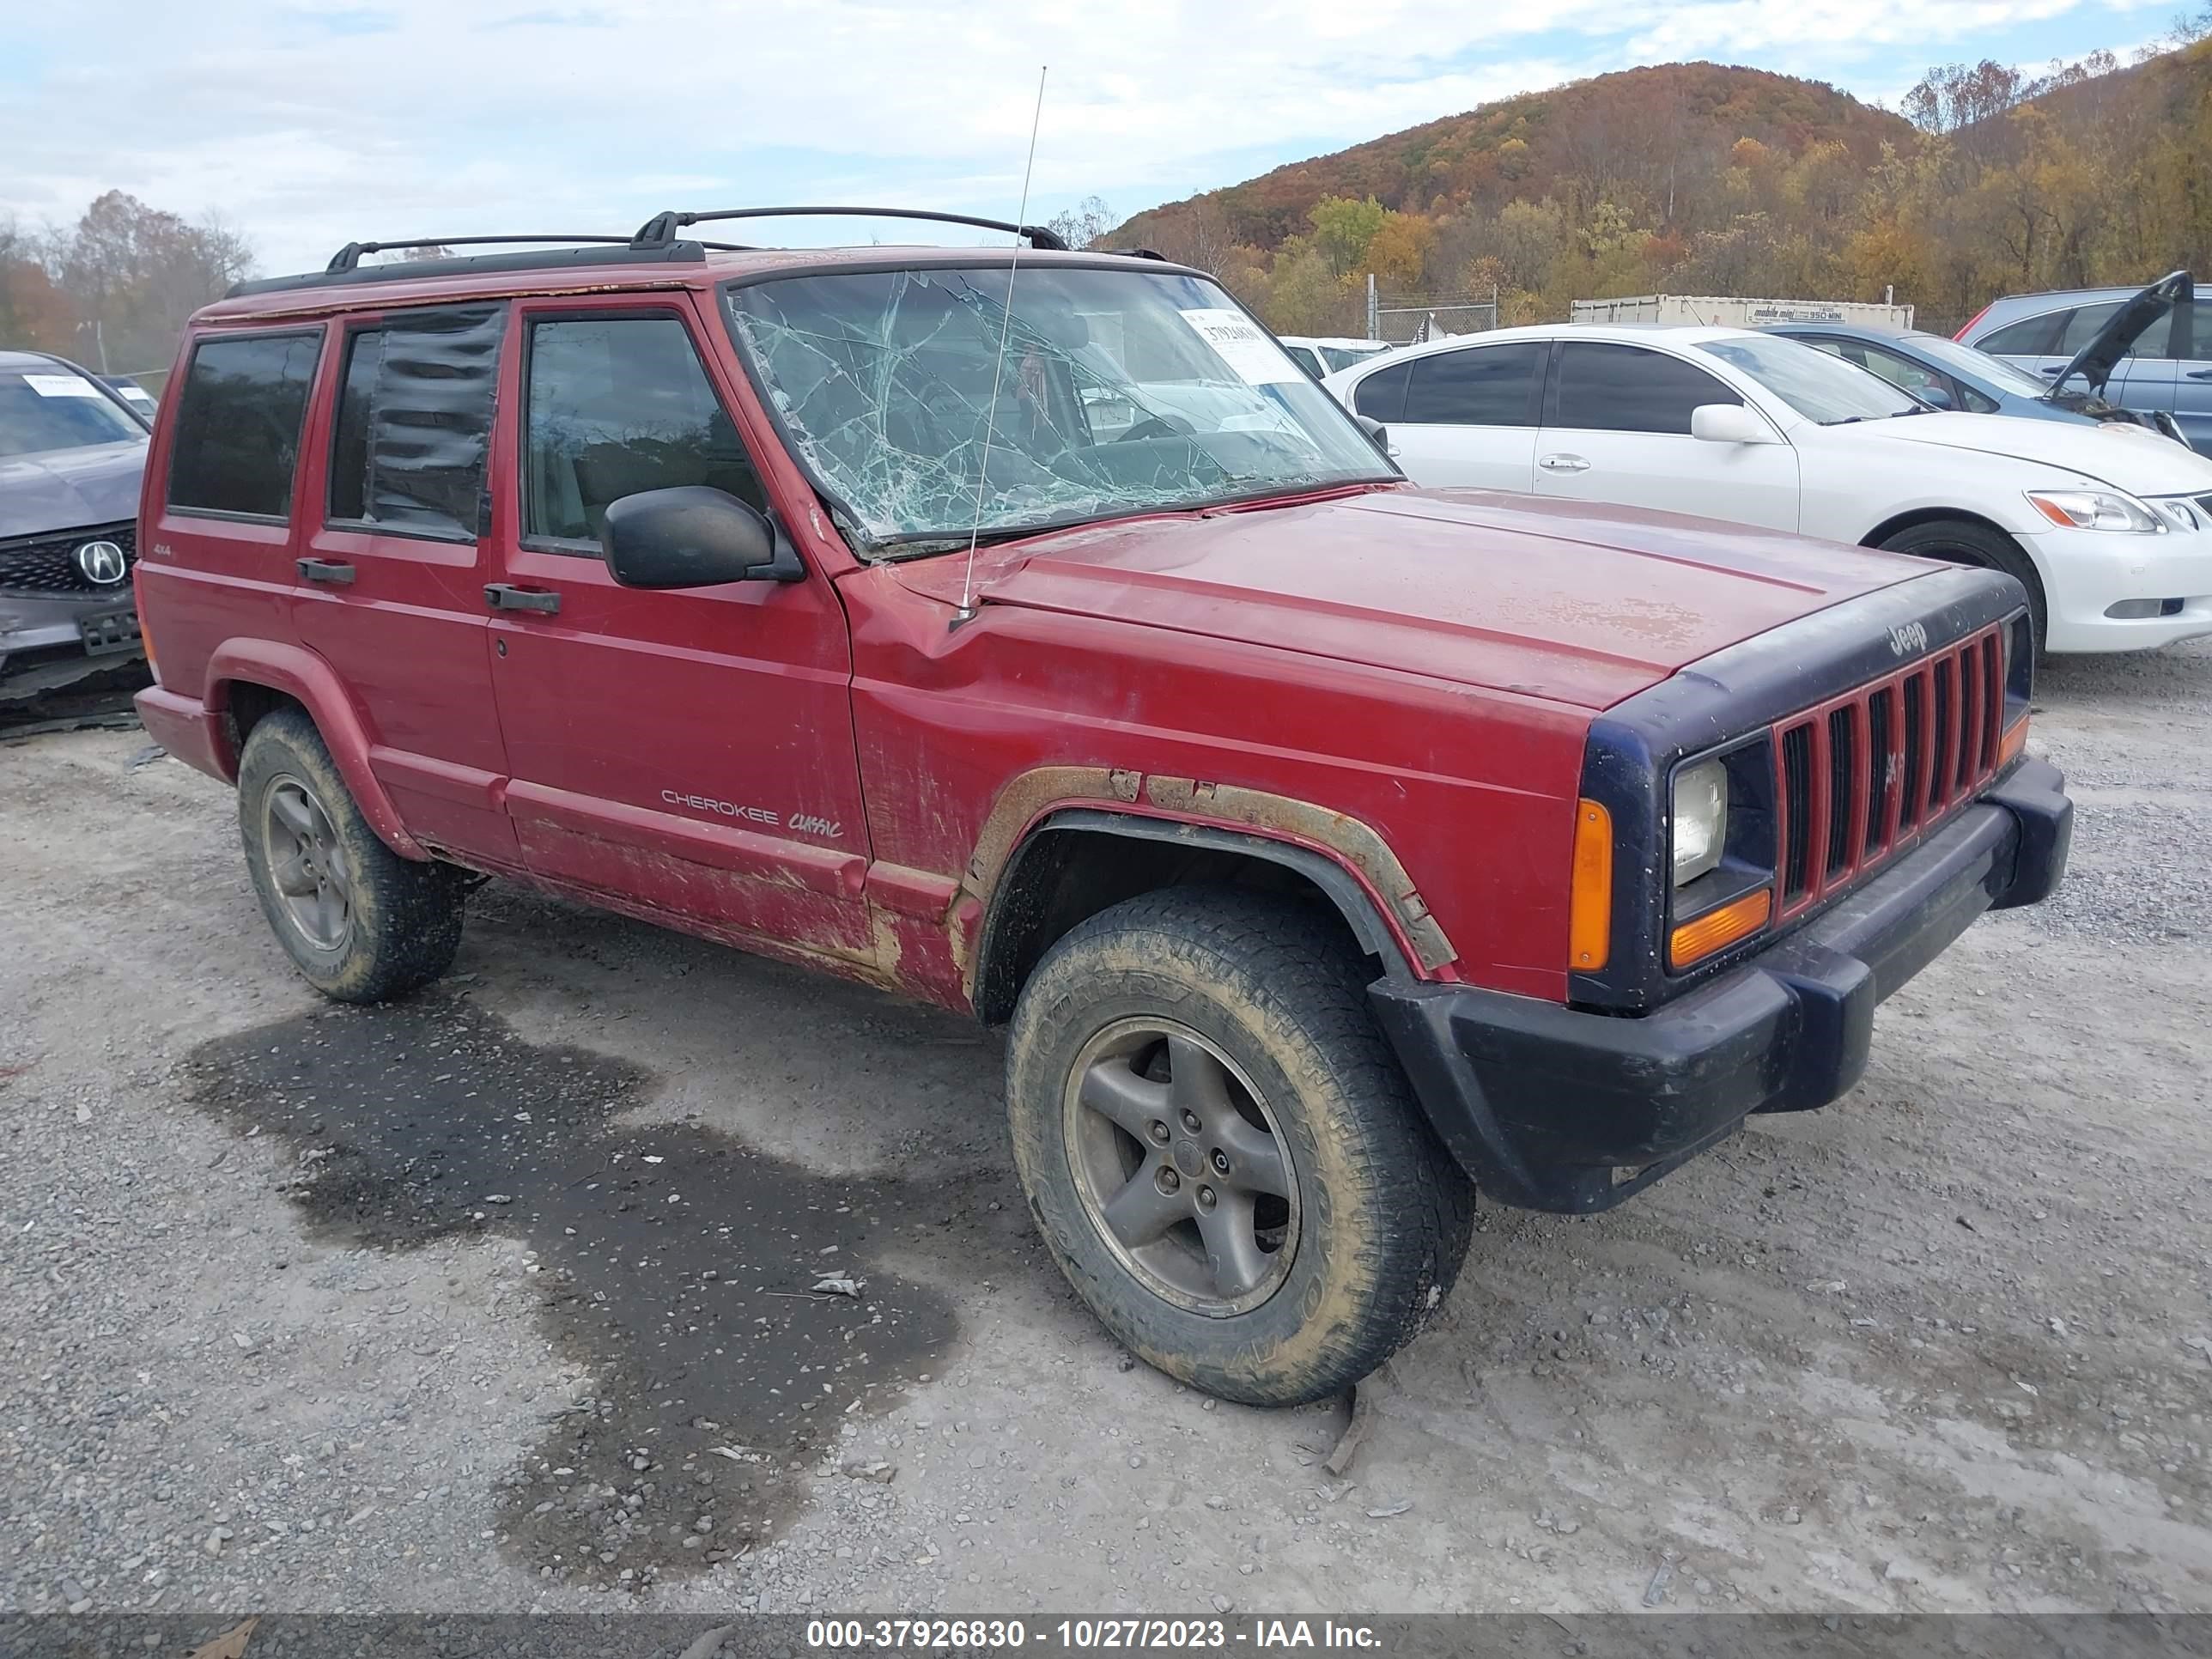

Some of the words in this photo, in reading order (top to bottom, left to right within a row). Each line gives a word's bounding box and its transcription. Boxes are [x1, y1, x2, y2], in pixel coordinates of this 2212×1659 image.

[1754, 306, 1778, 318] mobile
[1779, 309, 1796, 319] mini
[1886, 622, 1928, 656] Jeep
[661, 789, 780, 825] CHEROKEE
[788, 812, 844, 838] CLASSIC
